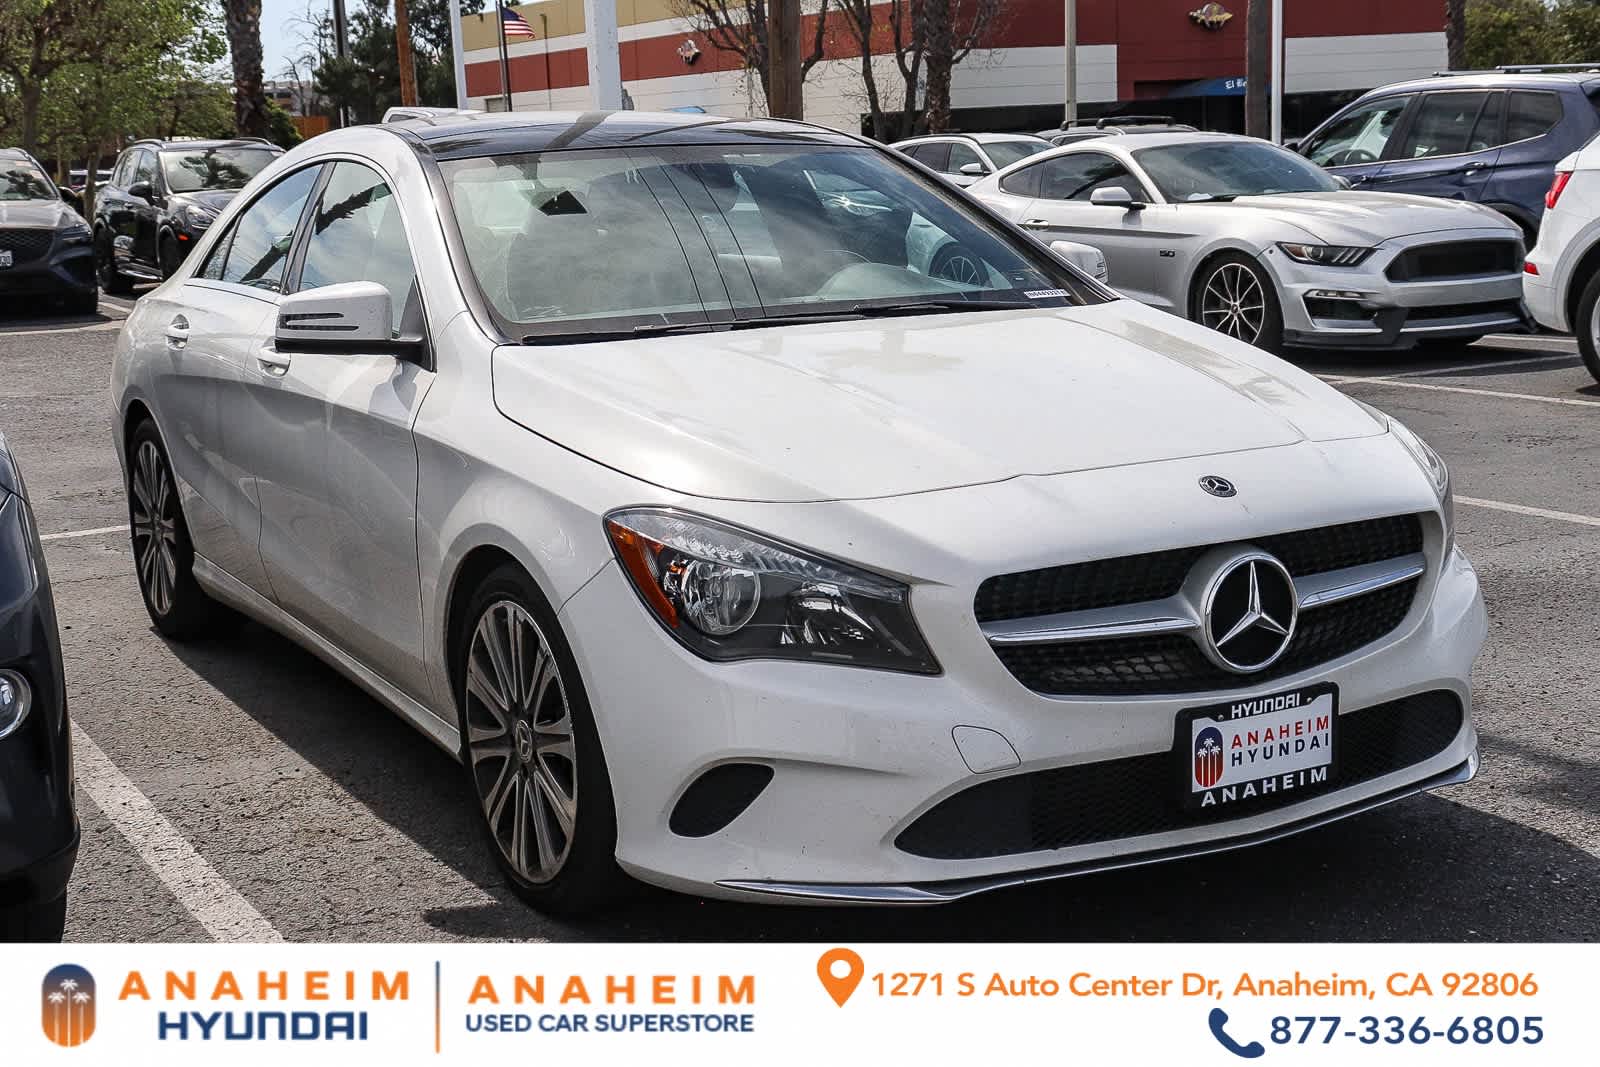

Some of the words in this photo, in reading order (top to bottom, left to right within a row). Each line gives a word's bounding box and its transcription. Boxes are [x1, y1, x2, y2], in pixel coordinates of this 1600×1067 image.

[1231, 693, 1300, 719] HYUNDAI
[1231, 715, 1329, 750] ANAHEIM
[1231, 733, 1329, 767] HYUNDAI
[1201, 767, 1327, 807] ANAHEIM
